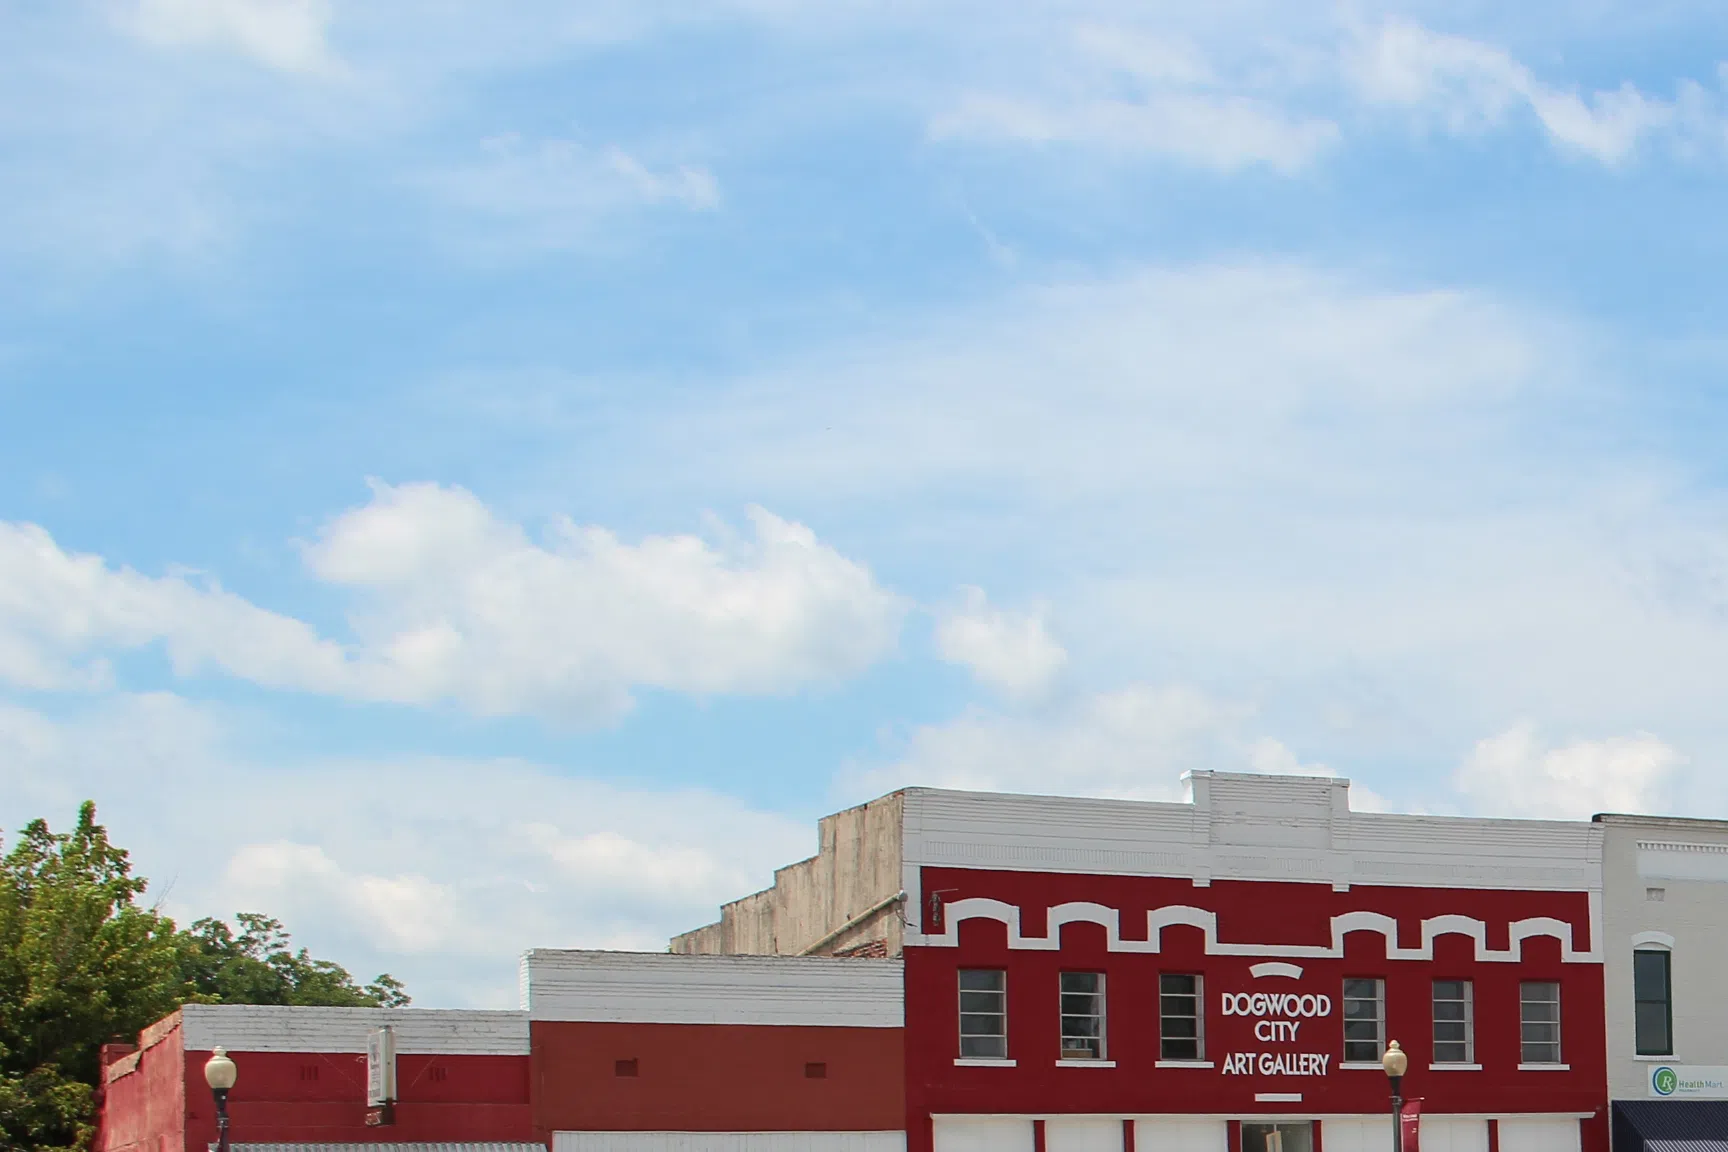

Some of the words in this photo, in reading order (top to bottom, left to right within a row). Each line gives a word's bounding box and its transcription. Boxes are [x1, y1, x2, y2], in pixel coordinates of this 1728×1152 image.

[1221, 992, 1331, 1018] DOGWOOD
[1254, 1020, 1300, 1042] CITY
[1221, 1052, 1257, 1075] ART
[1258, 1052, 1330, 1076] GALLERY
[1678, 1080, 1704, 1088] Health
